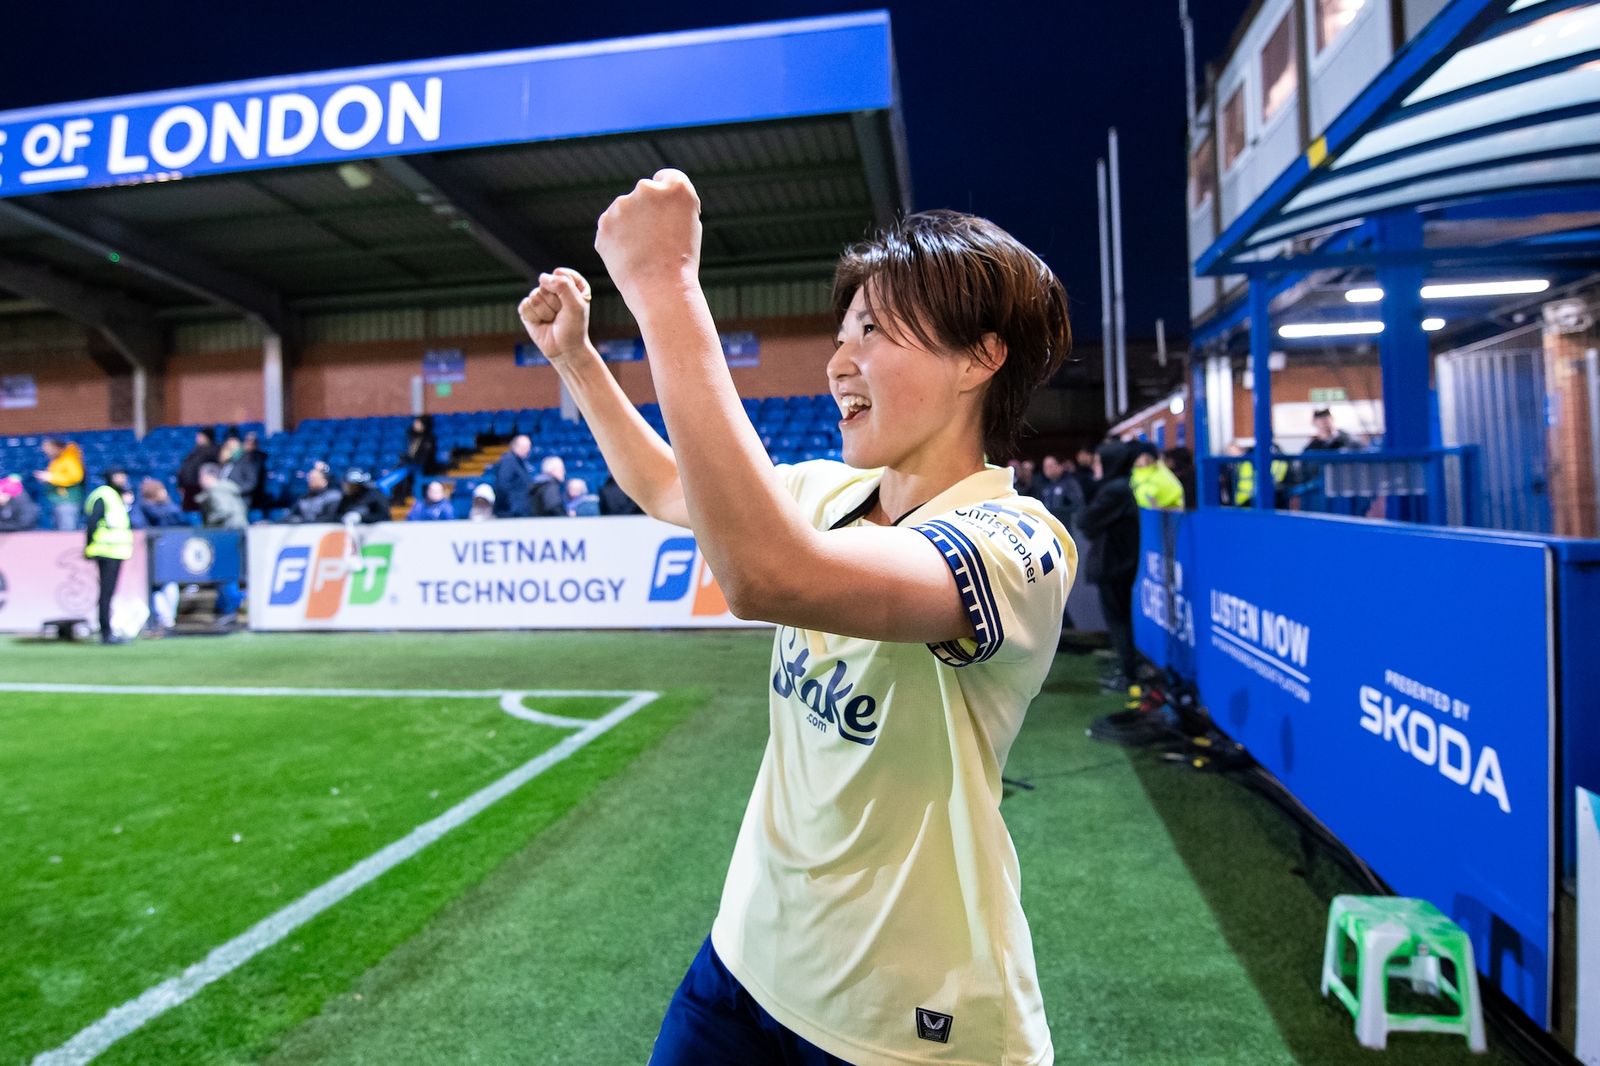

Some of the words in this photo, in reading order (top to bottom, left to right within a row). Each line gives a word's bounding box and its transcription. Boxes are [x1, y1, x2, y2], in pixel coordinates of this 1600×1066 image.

[22, 118, 94, 167] OF
[107, 77, 442, 175] LONDON
[270, 546, 391, 604] FPT
[451, 540, 586, 565] VIETNAM
[418, 579, 625, 604] TECHNOLOGY
[1210, 588, 1259, 643] LISTEN
[1261, 609, 1310, 668] NOW
[773, 626, 877, 745] Stake
[806, 713, 827, 733] .com
[1359, 685, 1512, 814] SKODA
